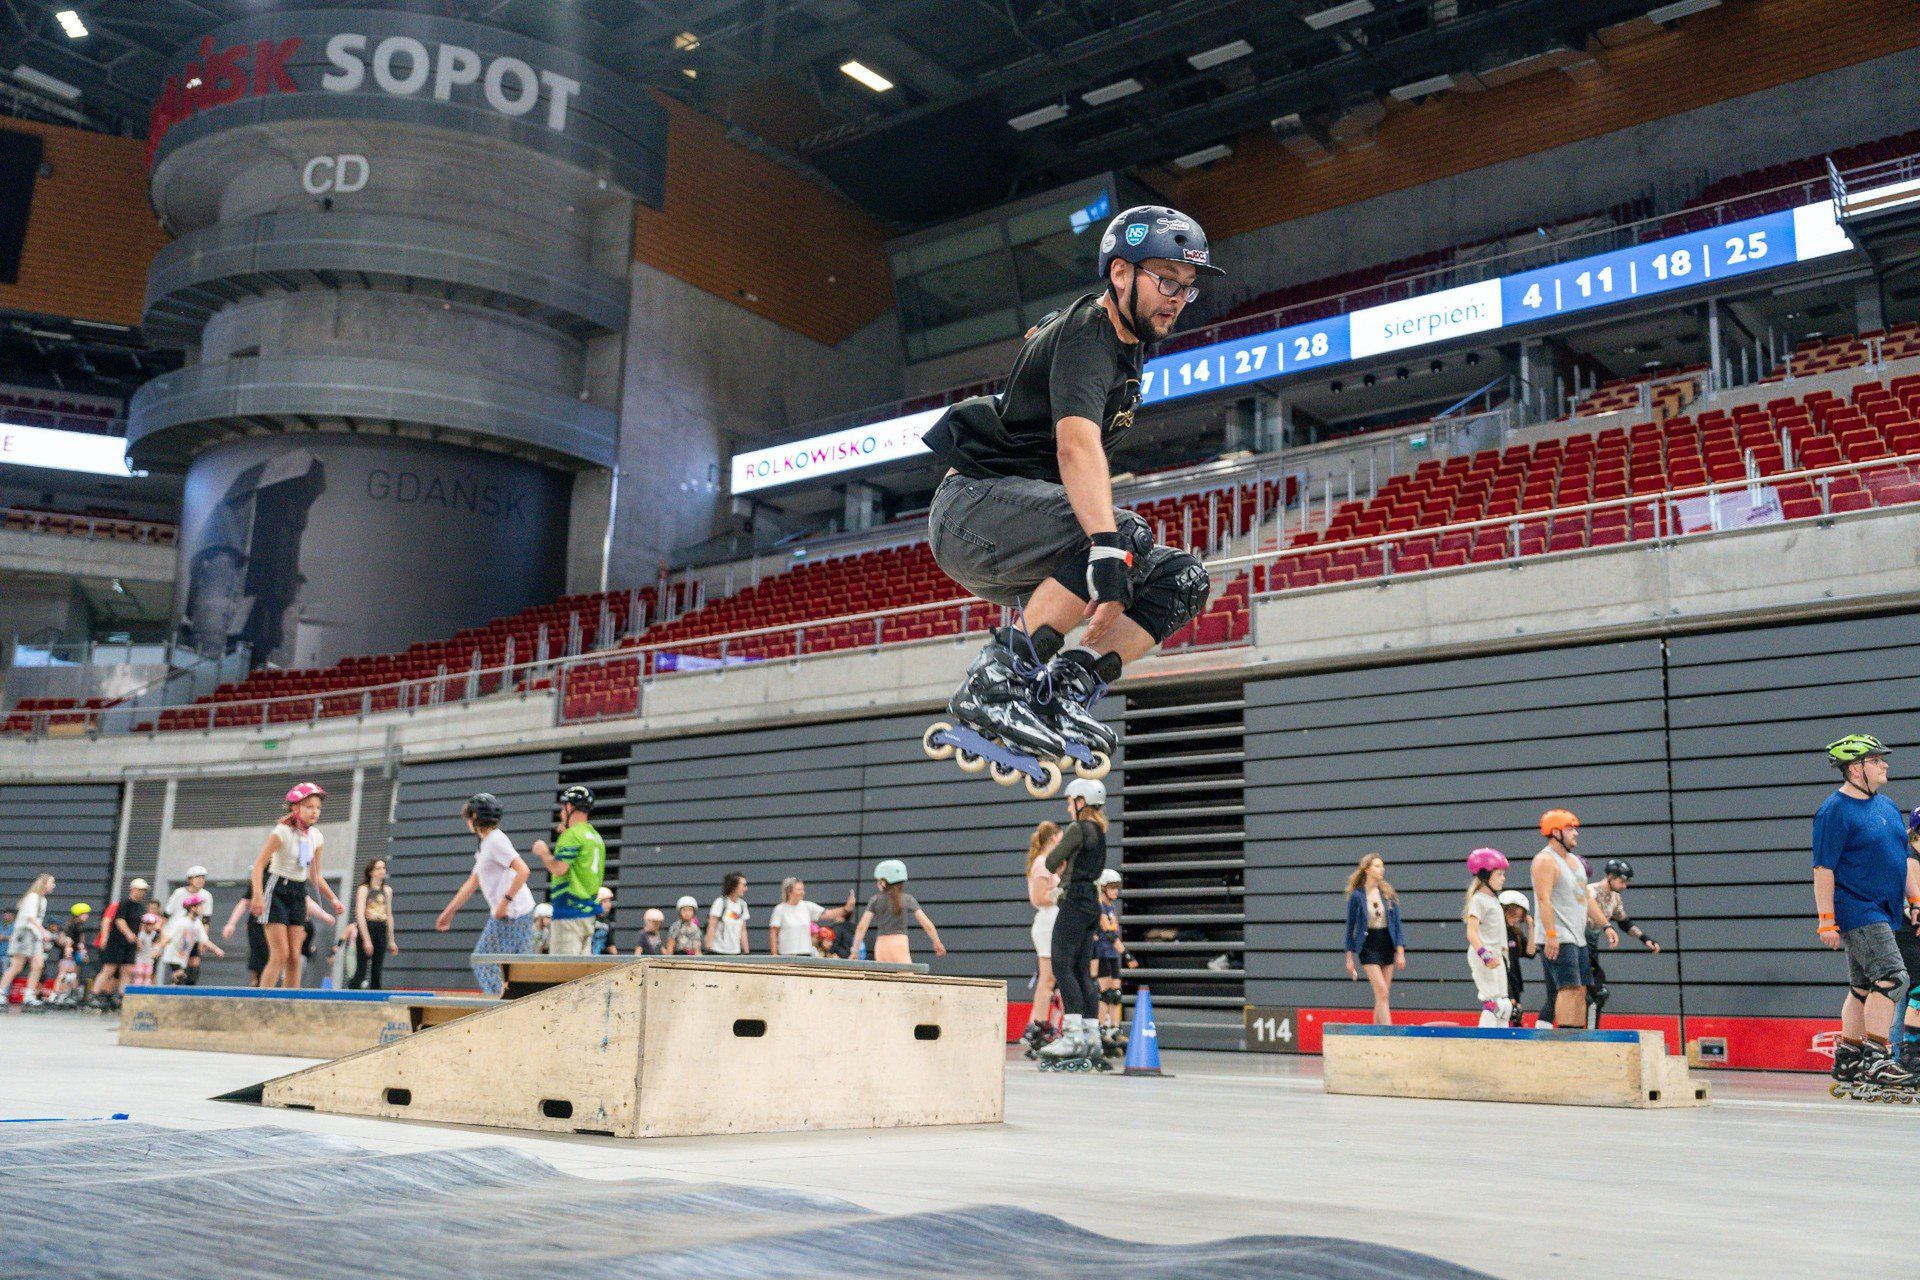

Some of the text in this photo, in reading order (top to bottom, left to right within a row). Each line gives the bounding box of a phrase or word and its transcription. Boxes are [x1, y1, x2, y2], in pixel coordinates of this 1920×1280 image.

[321, 33, 581, 131] SOPOT
[302, 154, 371, 194] CD
[1179, 359, 1211, 386] 14
[1235, 346, 1268, 374] 27
[1294, 332, 1329, 361] 28
[1383, 298, 1486, 339] sierpień:
[1522, 283, 1543, 309] 4
[1576, 266, 1613, 298] 11
[1652, 249, 1692, 280] 18
[1725, 231, 1768, 265] 25
[746, 436, 877, 481] ROLKOWISKO
[365, 467, 527, 525] GDAŃSK
[1252, 1017, 1293, 1043] 114
